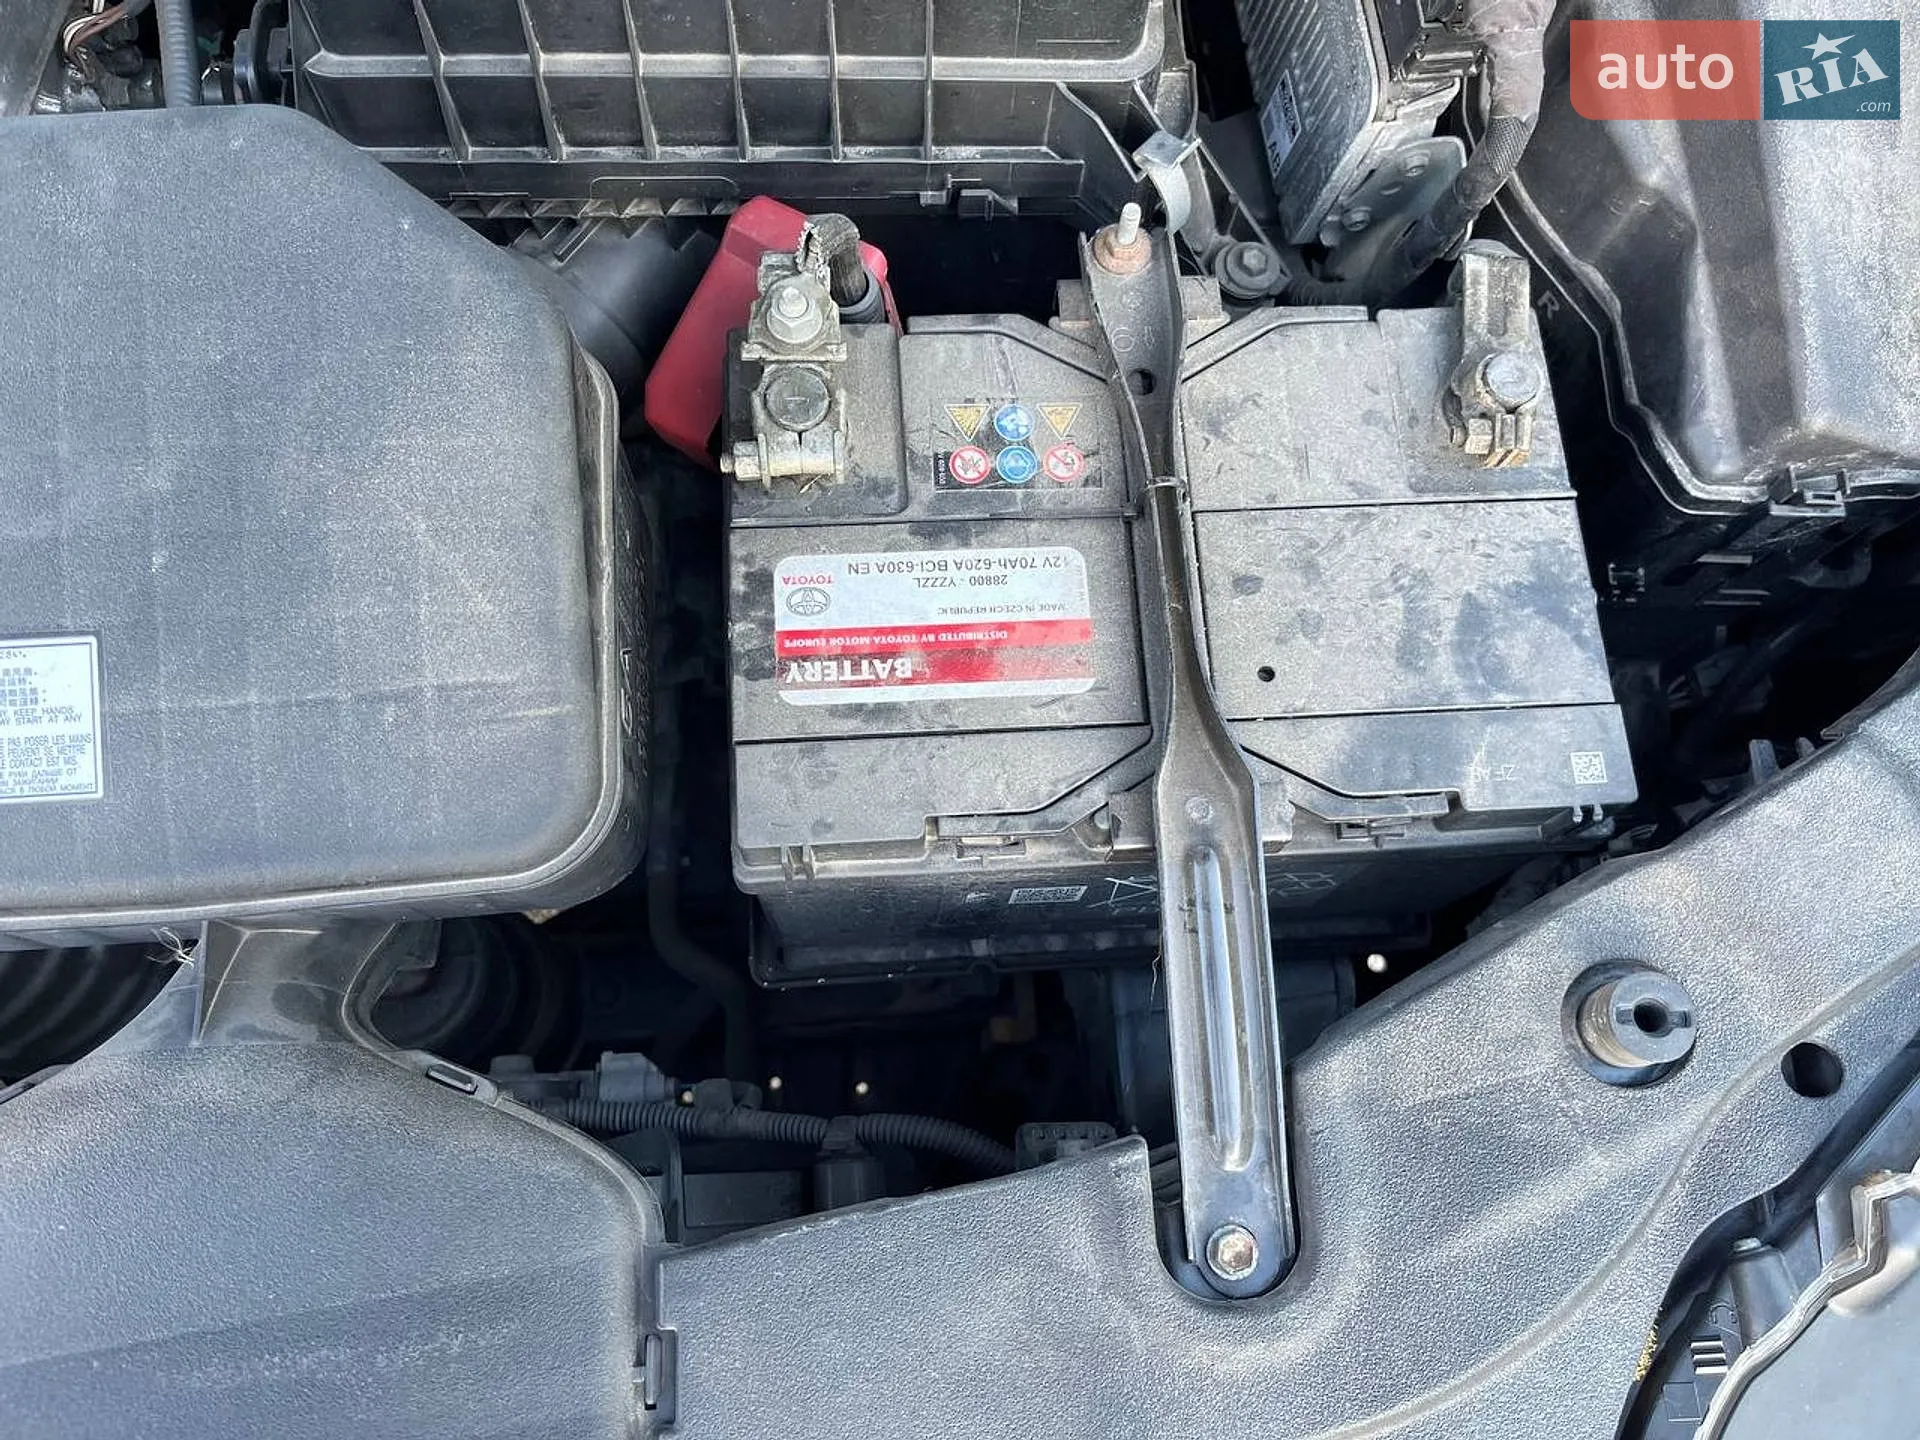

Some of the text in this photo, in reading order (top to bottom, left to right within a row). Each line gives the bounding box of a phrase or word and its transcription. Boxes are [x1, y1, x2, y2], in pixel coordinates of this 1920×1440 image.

[847, 562, 870, 576] EN
[953, 556, 1036, 572] 70Ah-620A
[782, 574, 834, 586] TOYOTA
[912, 575, 957, 588] YZZZL
[968, 574, 1009, 587] 28800
[937, 603, 1066, 616] MADE IN CZECH REPUBLIC
[784, 630, 1008, 648] DISTRIBUTED BY TOYOTA MOTOR EUROPE
[785, 657, 913, 684] BATTERY
[48, 714, 58, 724] AT
[24, 735, 49, 746] POSER
[52, 734, 65, 745] LES
[9, 756, 42, 769] CONTACT
[47, 756, 60, 767] EST
